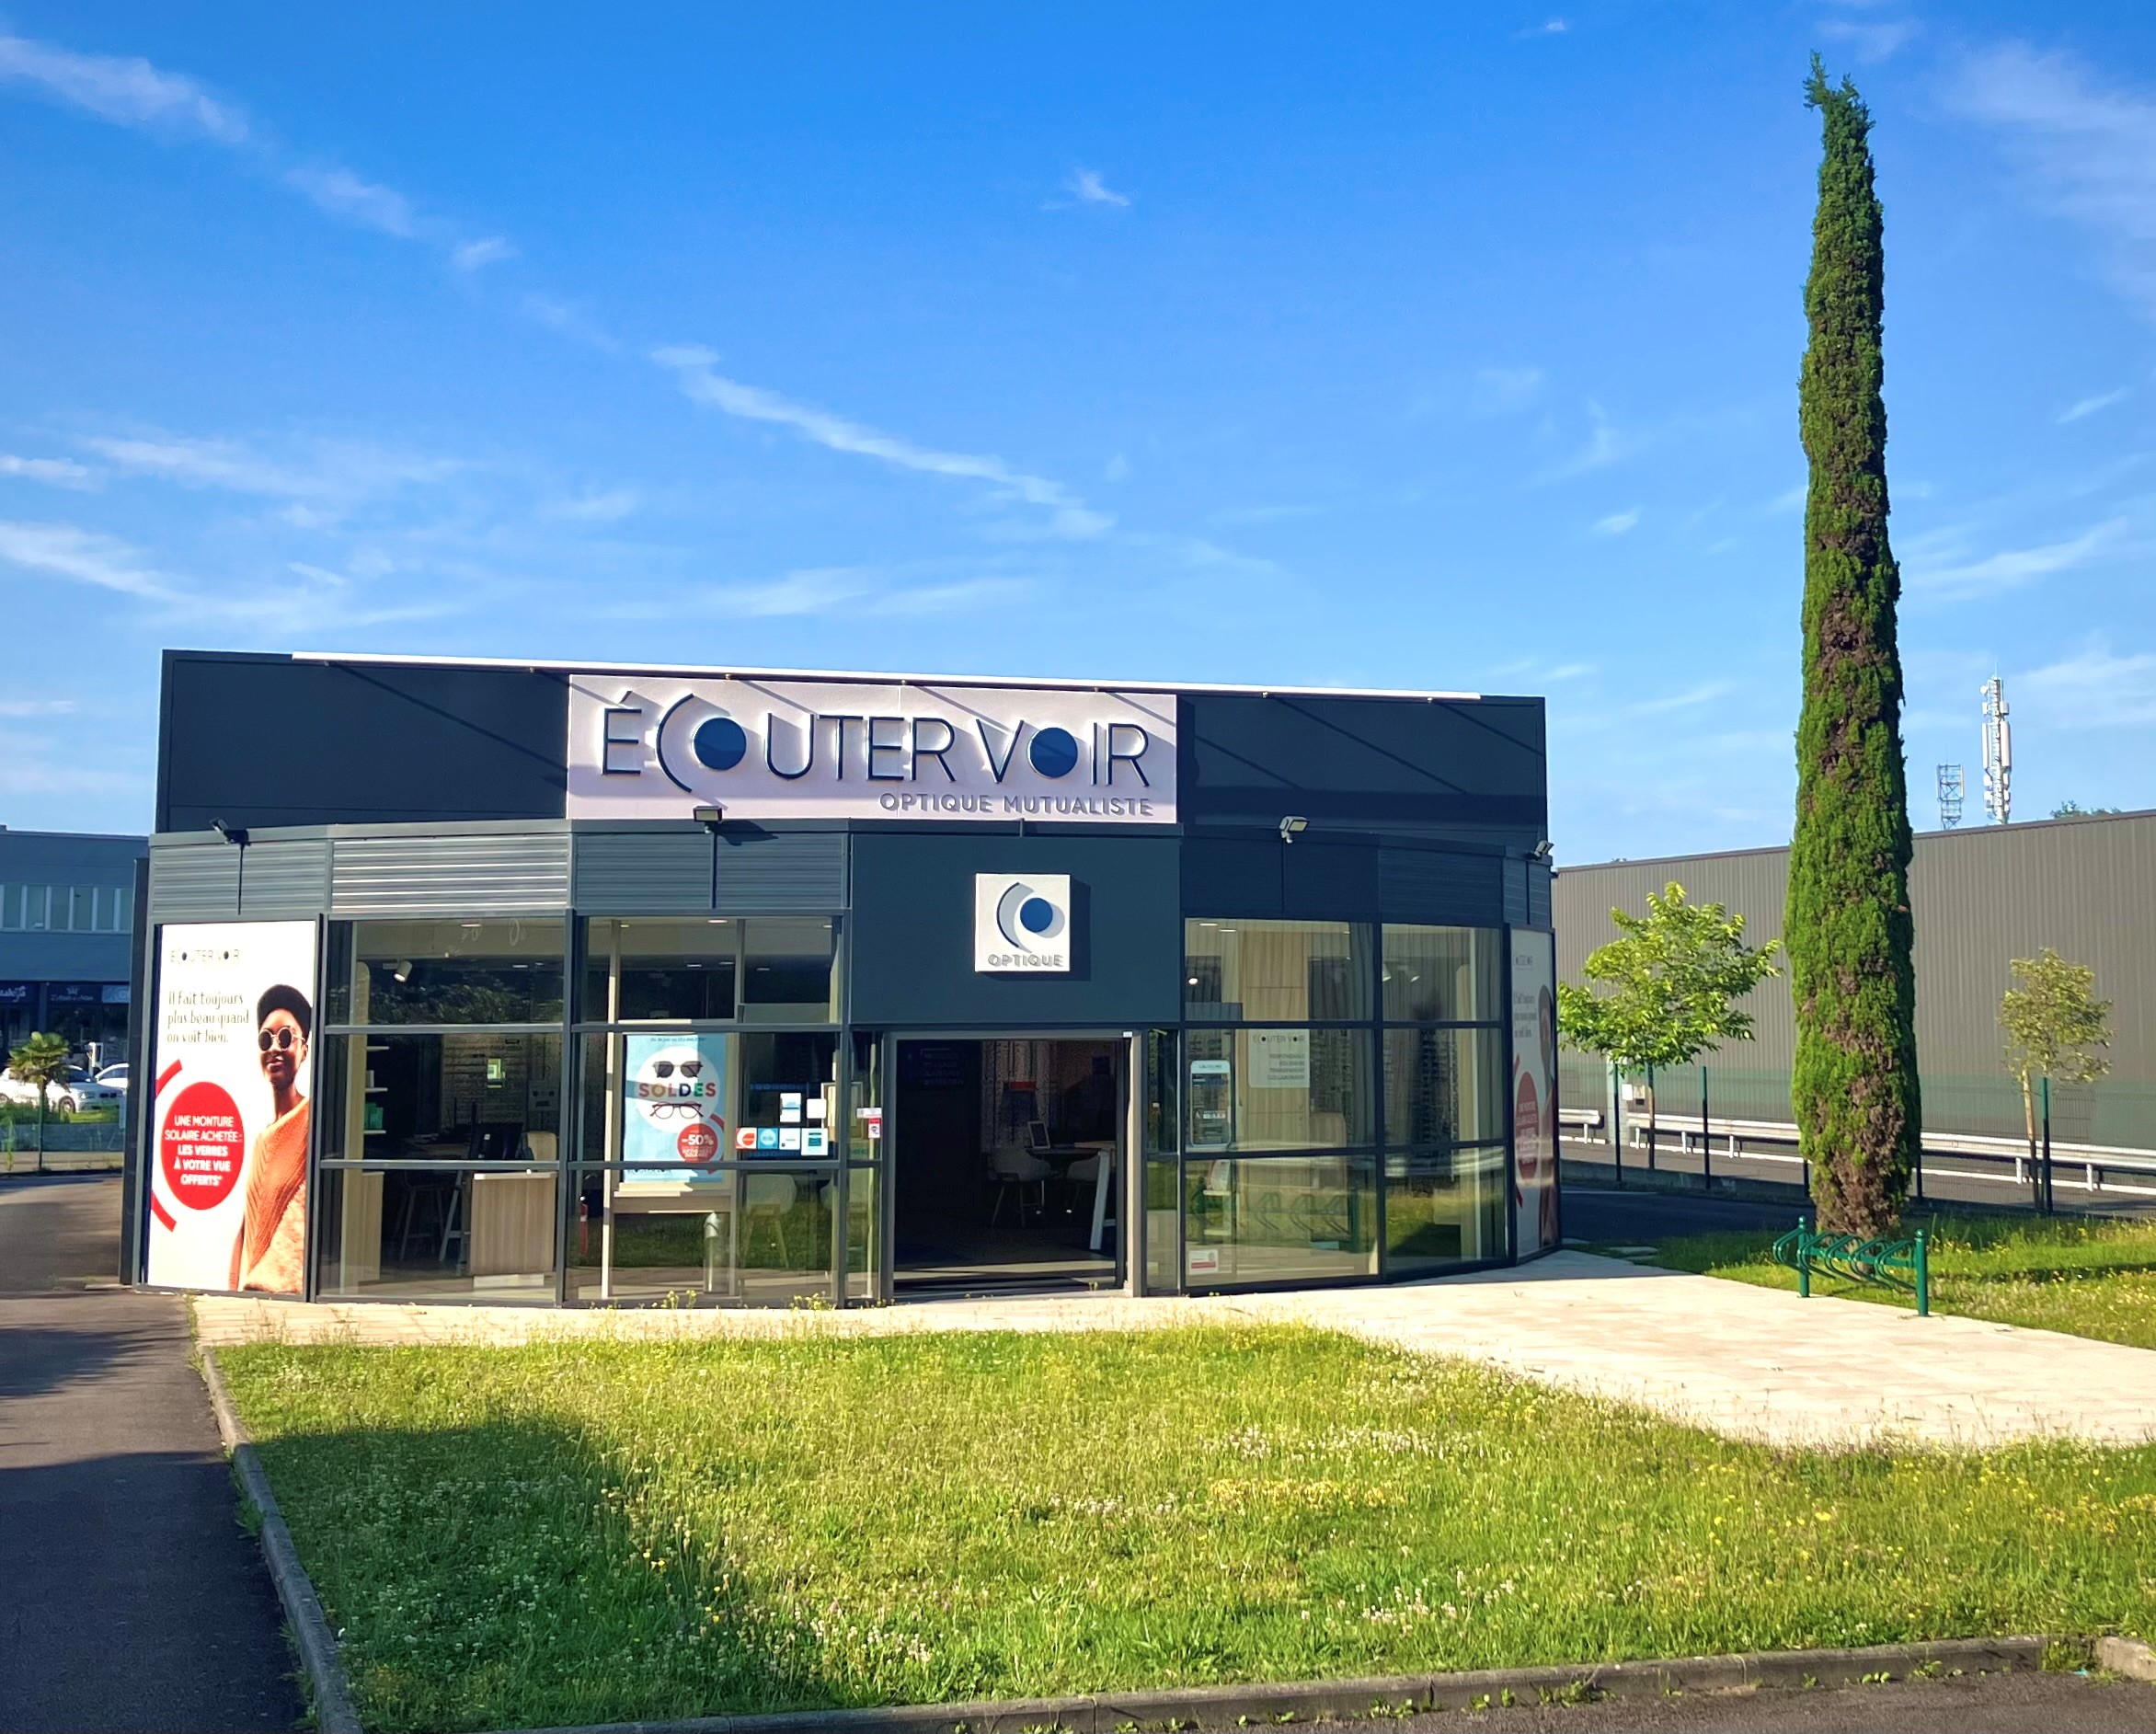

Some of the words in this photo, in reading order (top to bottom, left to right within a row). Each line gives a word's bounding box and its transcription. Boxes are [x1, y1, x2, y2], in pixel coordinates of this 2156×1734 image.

[602, 690, 957, 794] ÉCOUTER
[975, 718, 1150, 787] VOIR
[879, 791, 992, 813] OPTIQUE
[1003, 794, 1153, 817] MUTUALISTE
[987, 953, 1064, 967] OPTIQUE
[178, 991, 197, 1005] fait
[201, 991, 244, 1010] toujours
[167, 1010, 188, 1029] plus
[190, 1010, 215, 1024] beau
[218, 1009, 249, 1029] quand
[166, 1033, 179, 1042] on
[182, 1030, 201, 1042] voit
[638, 1082, 717, 1097] SOLDES
[174, 1115, 191, 1127] UNE
[192, 1115, 234, 1127] MONTURE
[165, 1129, 200, 1141] SOLAIRE
[178, 1144, 193, 1155] LES
[194, 1144, 228, 1157] VERRES
[182, 1159, 212, 1171] VOTRE
[212, 1160, 231, 1172] VUE
